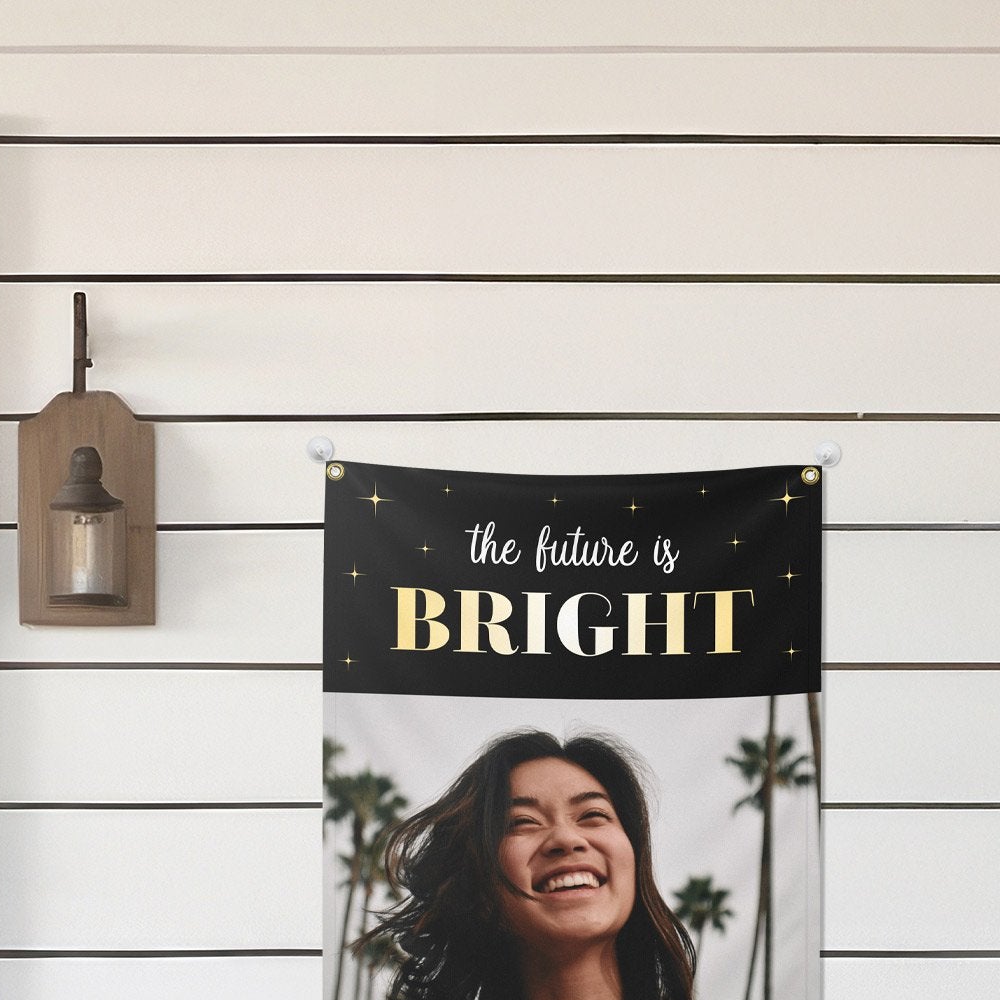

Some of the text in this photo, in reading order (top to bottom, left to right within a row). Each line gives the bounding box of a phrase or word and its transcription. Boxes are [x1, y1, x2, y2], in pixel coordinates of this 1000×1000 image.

[464, 520, 681, 574] the future is
[389, 586, 756, 657] BRIGHT
